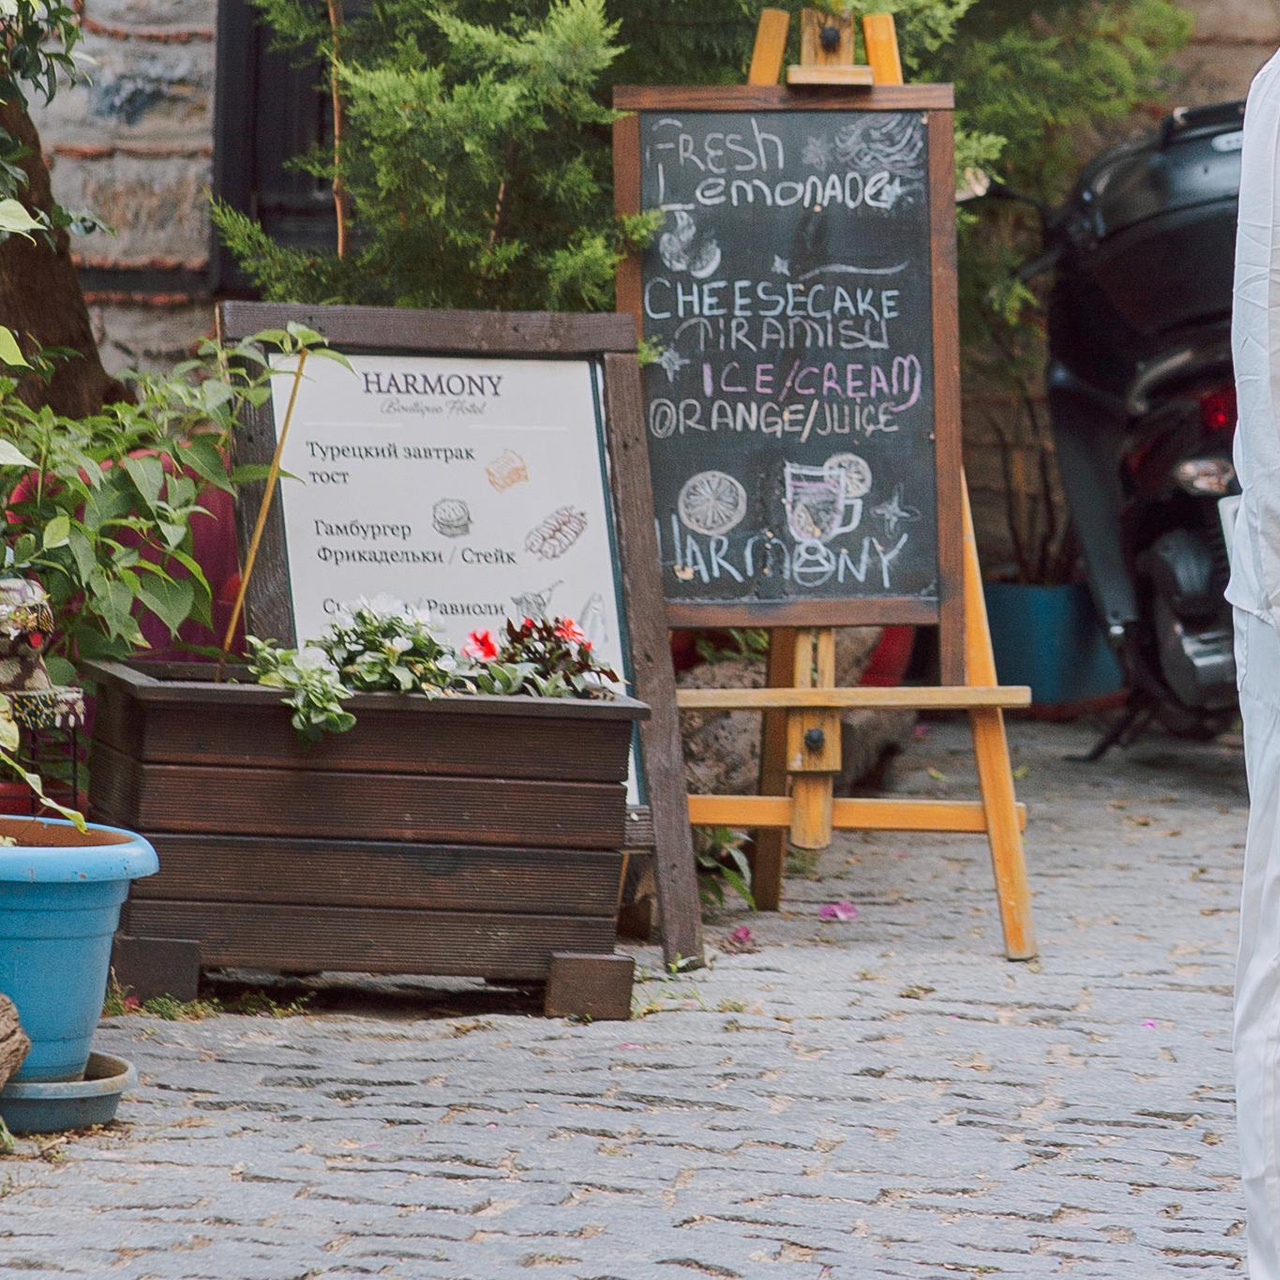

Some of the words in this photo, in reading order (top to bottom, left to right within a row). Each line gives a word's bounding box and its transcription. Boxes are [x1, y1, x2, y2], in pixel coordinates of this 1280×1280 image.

[644, 277, 899, 320] CHEESECAKE
[362, 371, 503, 397] HARMONY
[306, 440, 399, 463] Турецкий
[402, 445, 476, 463] завтрак
[309, 471, 349, 484] тост
[314, 520, 412, 539] Гамбургер
[316, 547, 443, 566] Фрикадельки
[461, 548, 517, 564] Стейк
[427, 599, 505, 616] Равиоли
